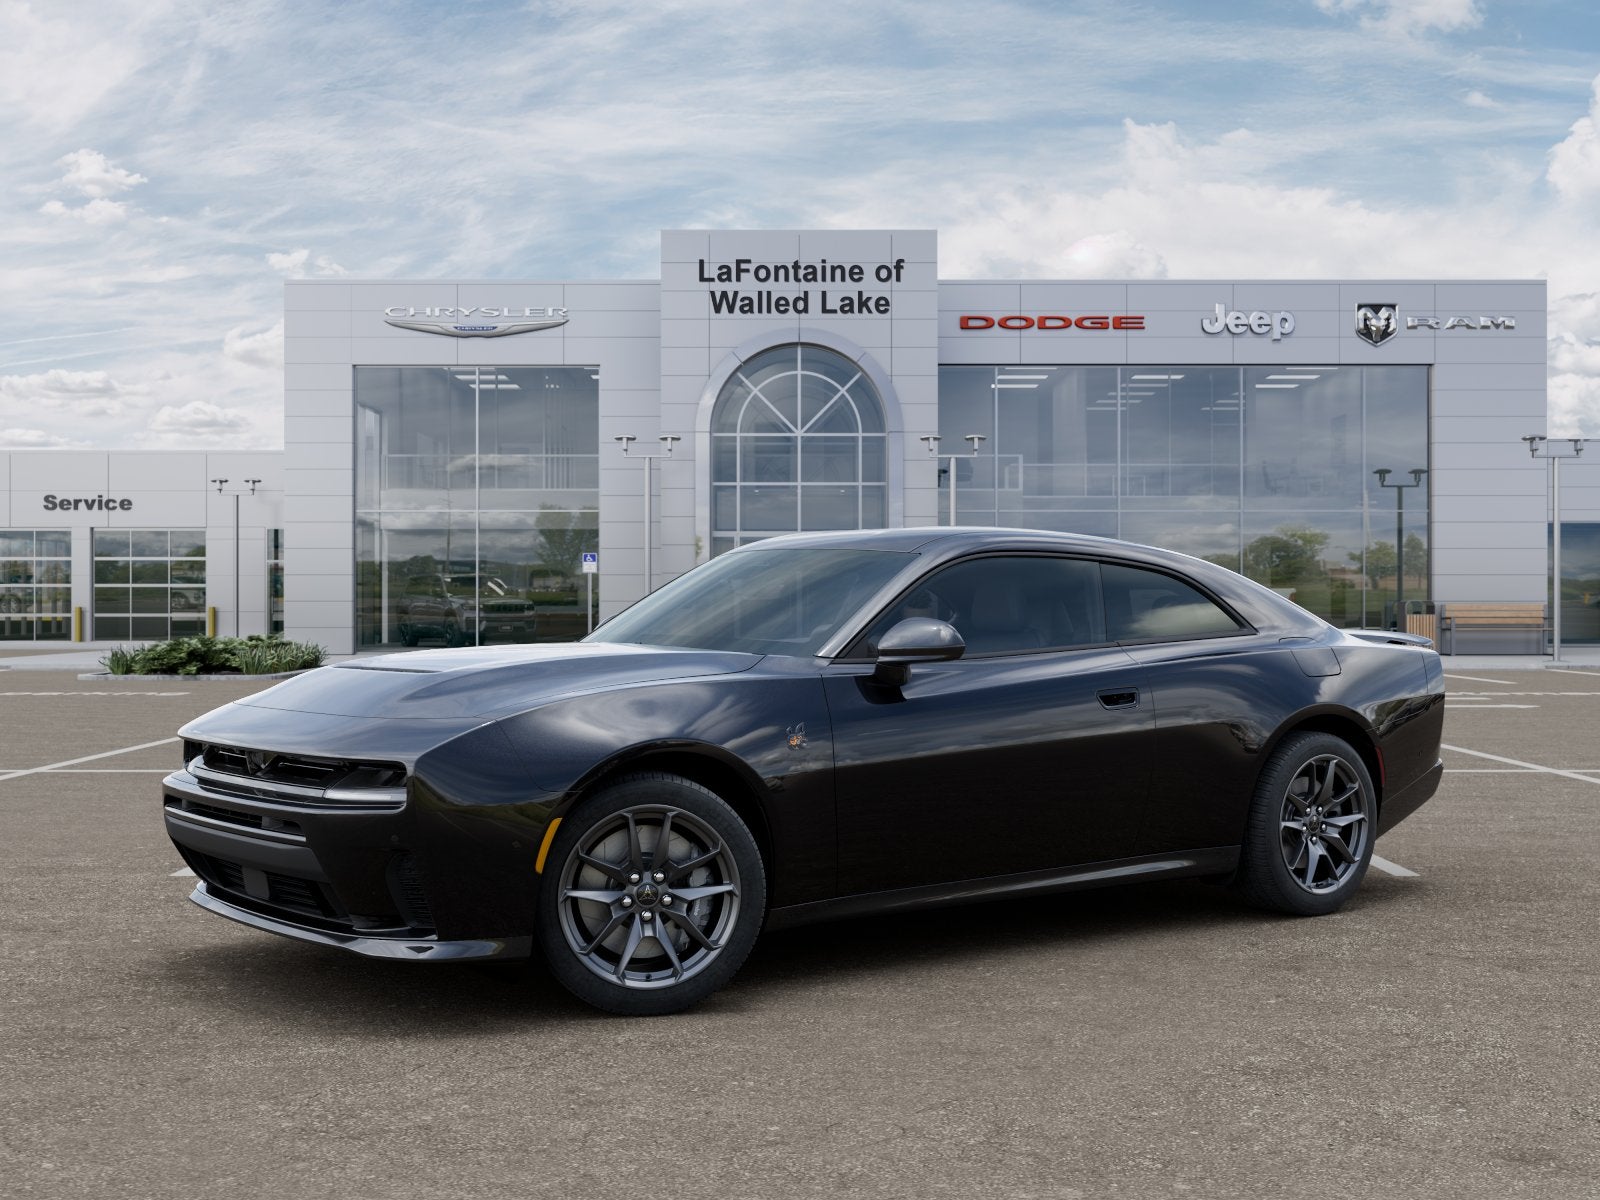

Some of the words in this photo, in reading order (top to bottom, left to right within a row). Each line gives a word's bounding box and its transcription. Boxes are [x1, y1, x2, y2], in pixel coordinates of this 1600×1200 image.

[698, 259, 865, 283] LaFontaine
[874, 259, 905, 283] of
[710, 290, 809, 315] Walled
[821, 290, 891, 315] Lake
[384, 306, 569, 318] CHRYSLER
[959, 315, 1146, 330] DODGE
[1201, 303, 1296, 342] Jeep
[1406, 316, 1516, 330] RAM
[43, 494, 133, 511] Service
